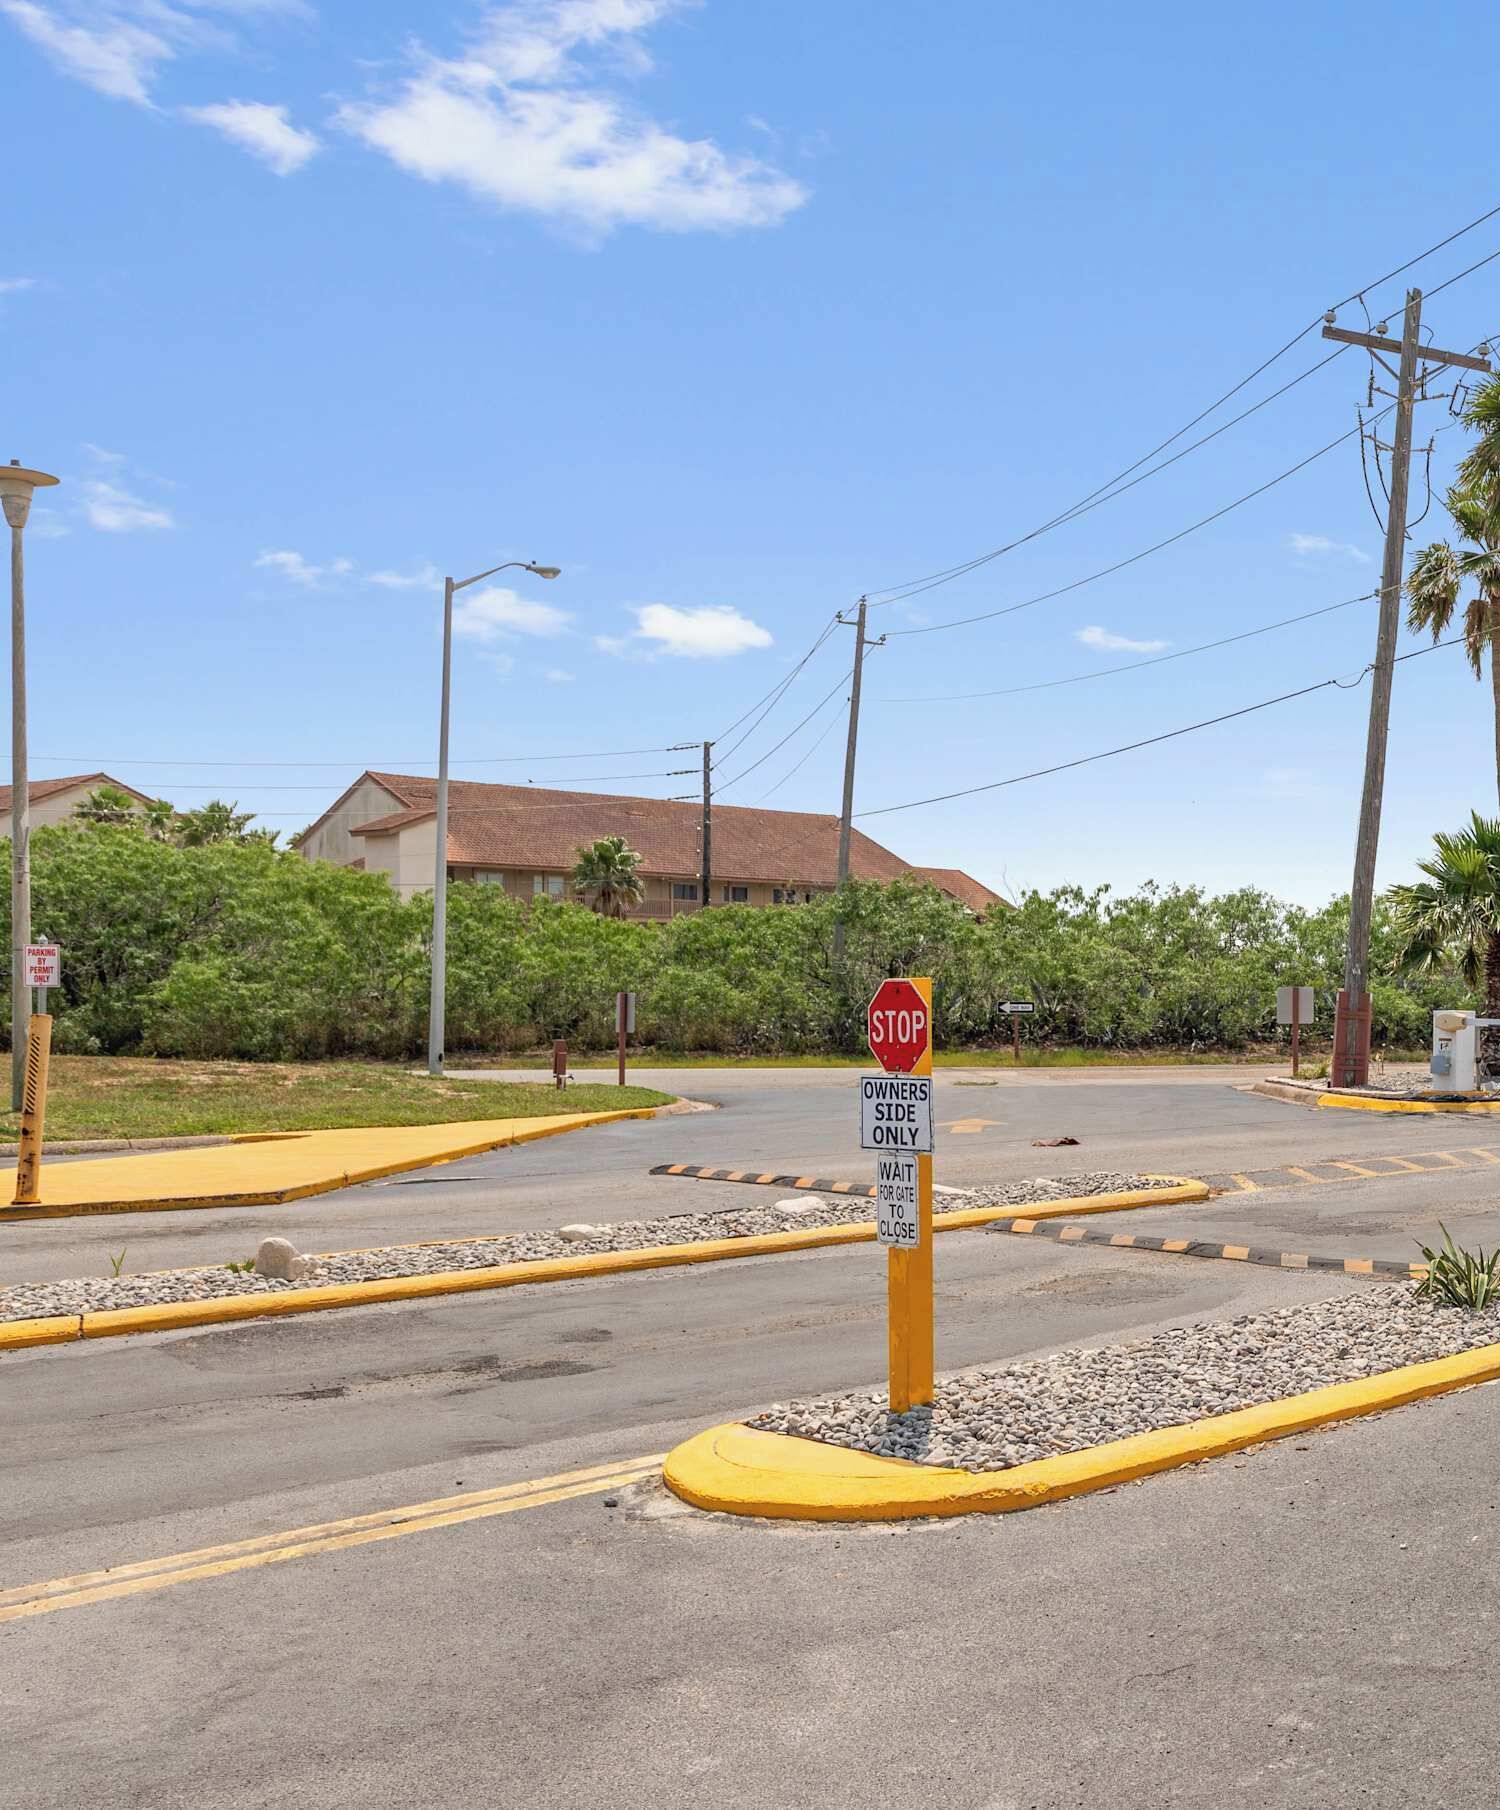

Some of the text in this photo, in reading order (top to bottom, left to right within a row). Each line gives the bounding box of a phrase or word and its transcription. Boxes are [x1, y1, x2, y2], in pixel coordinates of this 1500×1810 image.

[27, 948, 56, 957] PARKING
[37, 957, 46, 965] BY
[30, 966, 54, 974] PERMIT
[34, 975, 50, 983] ONLY
[872, 1010, 925, 1044] STOP
[863, 1081, 928, 1102] OWNERS
[875, 1102, 916, 1123] SIDE
[873, 1125, 919, 1146] ONLY
[879, 1161, 914, 1183] WAIT
[880, 1184, 914, 1203] FOR GATE
[888, 1203, 905, 1220] TO
[880, 1220, 916, 1240] CLOSE
